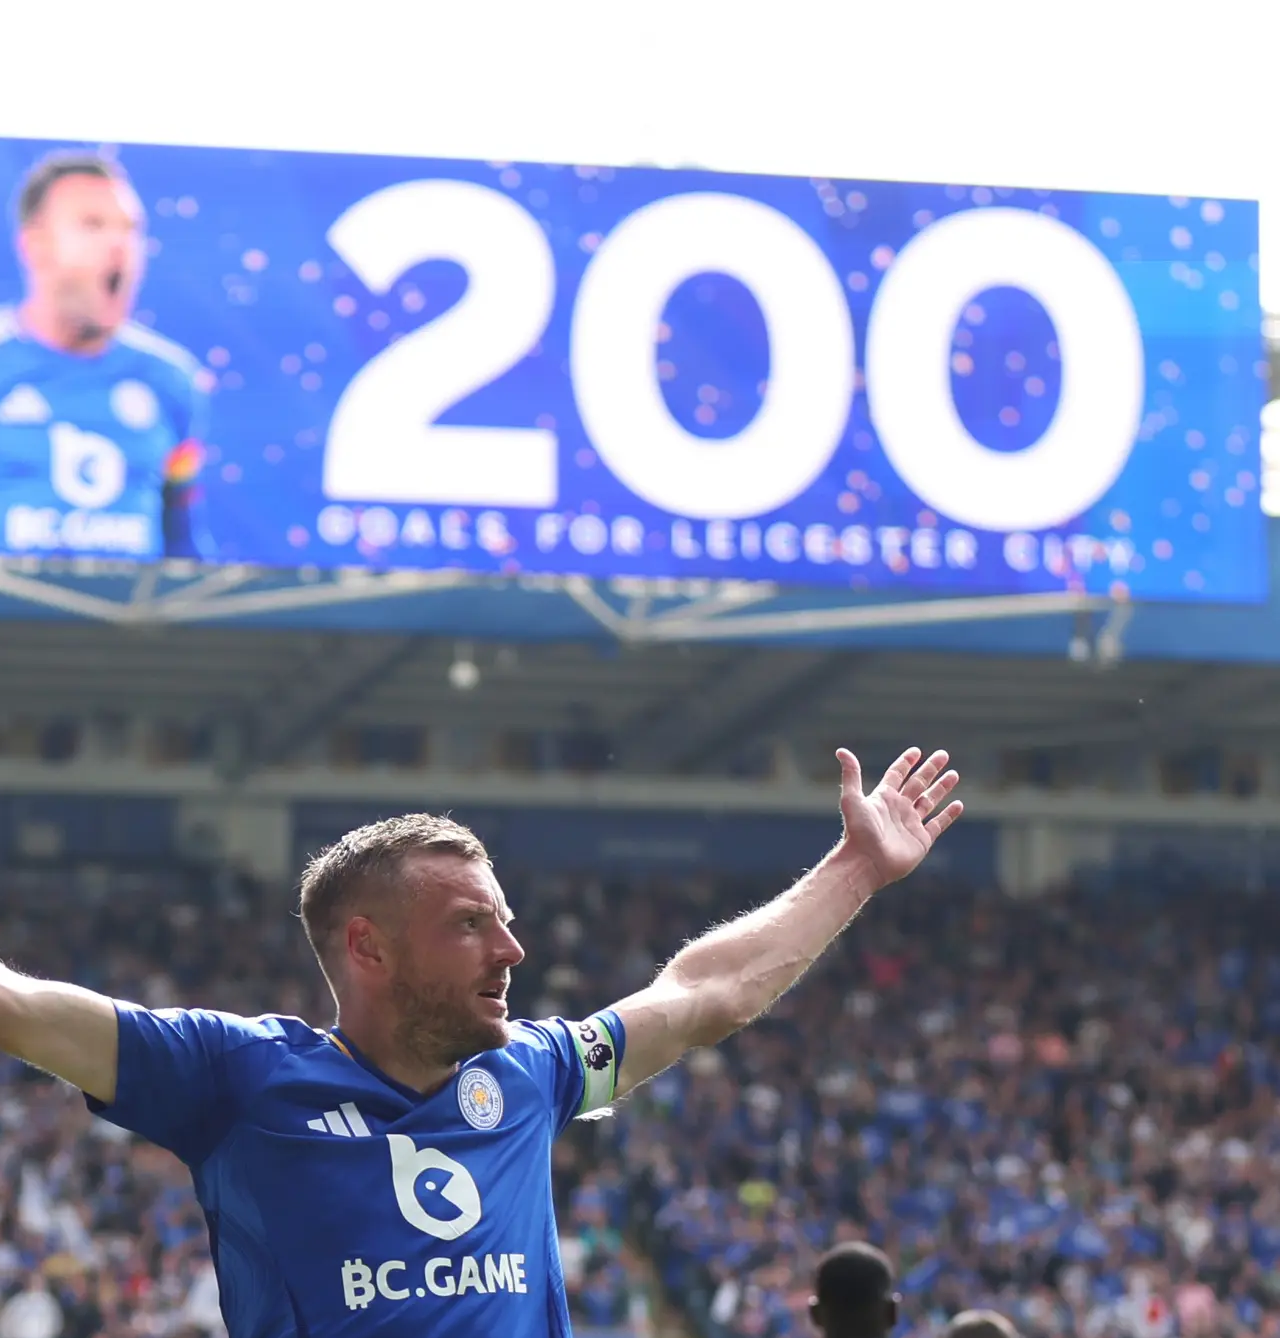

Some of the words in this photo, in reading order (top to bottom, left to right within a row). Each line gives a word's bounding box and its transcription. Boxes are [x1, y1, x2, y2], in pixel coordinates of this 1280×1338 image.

[323, 178, 1145, 533] 200
[316, 505, 512, 553] GOALS
[535, 512, 644, 555] FOR
[671, 518, 978, 570] LEICESTER
[1003, 530, 1137, 575] CITY
[341, 1254, 528, 1310] BC.GAME
